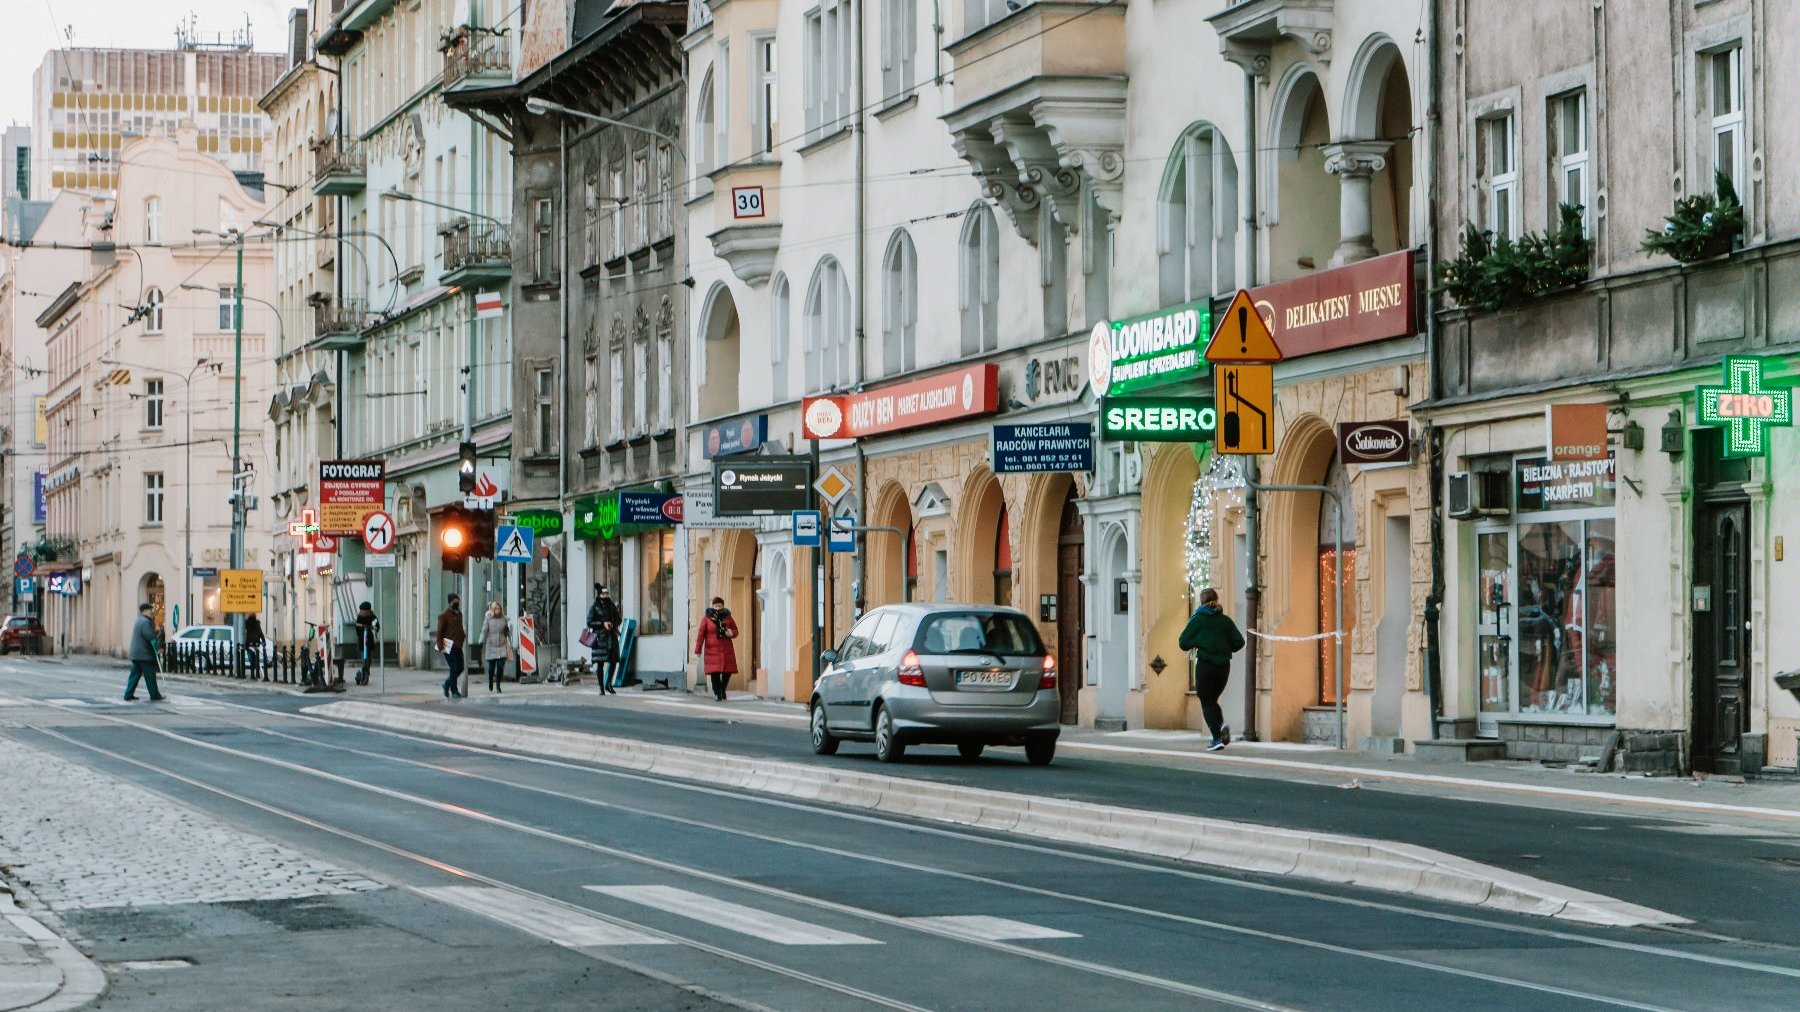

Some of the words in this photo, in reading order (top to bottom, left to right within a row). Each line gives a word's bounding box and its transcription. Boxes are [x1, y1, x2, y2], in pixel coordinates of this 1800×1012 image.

[738, 194, 760, 210] 30
[1286, 294, 1351, 330] DELIKATESY
[1358, 283, 1401, 317] MIĘSNE
[1111, 310, 1198, 361] LOOMBARD
[852, 396, 875, 430] DUŻY
[877, 395, 894, 426] BEN
[897, 396, 919, 416] MARKET
[919, 385, 957, 411] ALKOHOLOWY
[1107, 407, 1216, 431] SREBRO
[1014, 426, 1070, 437] KANCELARIA
[996, 438, 1036, 451] RADCÓW
[1039, 438, 1090, 450] PRAWNYCH
[1355, 431, 1397, 450] Sobkowiak
[1554, 444, 1601, 457] orange
[322, 464, 382, 478] FOTOGRAF
[739, 473, 759, 482] Rynek
[1523, 464, 1562, 483] BIELIZNA
[1569, 458, 1615, 478] RAJSTOPY
[1544, 482, 1594, 501] SKARPETKI
[624, 497, 650, 506] Wypieki
[20, 579, 30, 592] P
